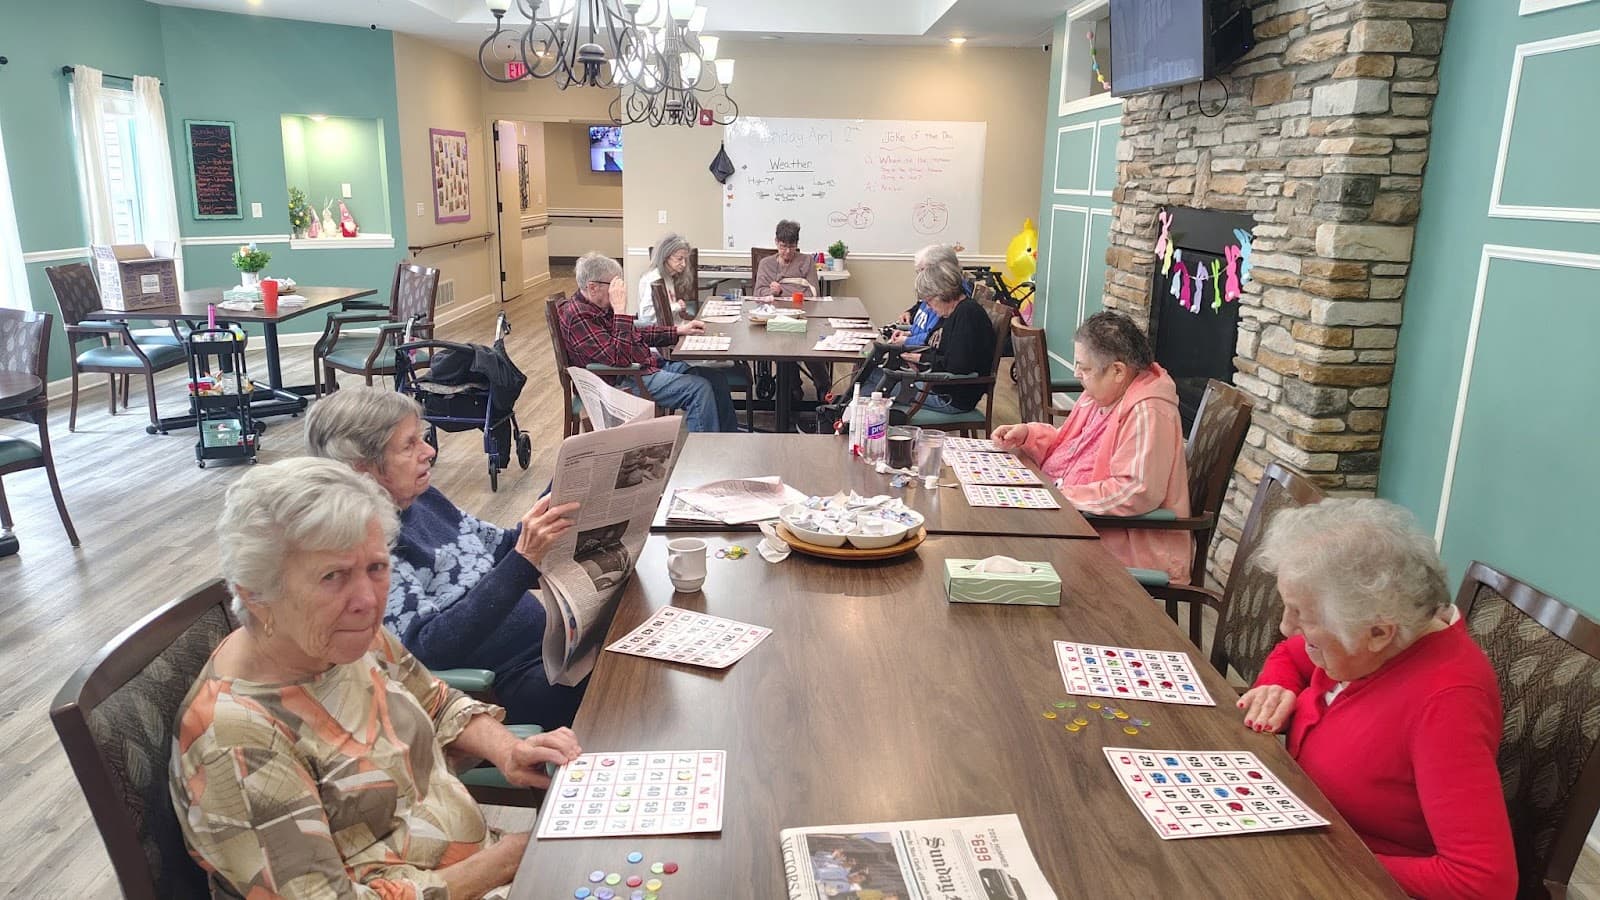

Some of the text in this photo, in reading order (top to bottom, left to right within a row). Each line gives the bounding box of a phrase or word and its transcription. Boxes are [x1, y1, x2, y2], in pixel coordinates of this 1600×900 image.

[881, 131, 905, 144] Joke
[769, 157, 814, 171] Weather
[626, 756, 640, 766] 14
[1138, 755, 1155, 767] 62
[1186, 756, 1204, 768] 65
[1235, 757, 1251, 766] 71
[650, 771, 664, 781] 21
[1199, 772, 1217, 783] 50
[647, 785, 661, 797] 40
[674, 785, 689, 796] 43
[1162, 790, 1177, 799] 41
[1187, 788, 1205, 799] 36
[1210, 756, 1284, 824] 11 26 57 63
[583, 772, 611, 830] 22 39 56 61
[644, 801, 659, 813] 59
[672, 801, 687, 812] 60
[559, 803, 575, 815] 58
[1174, 805, 1192, 815] 18
[1200, 803, 1219, 815] 20
[553, 820, 570, 831] 64
[922, 836, 956, 893] Sunday
